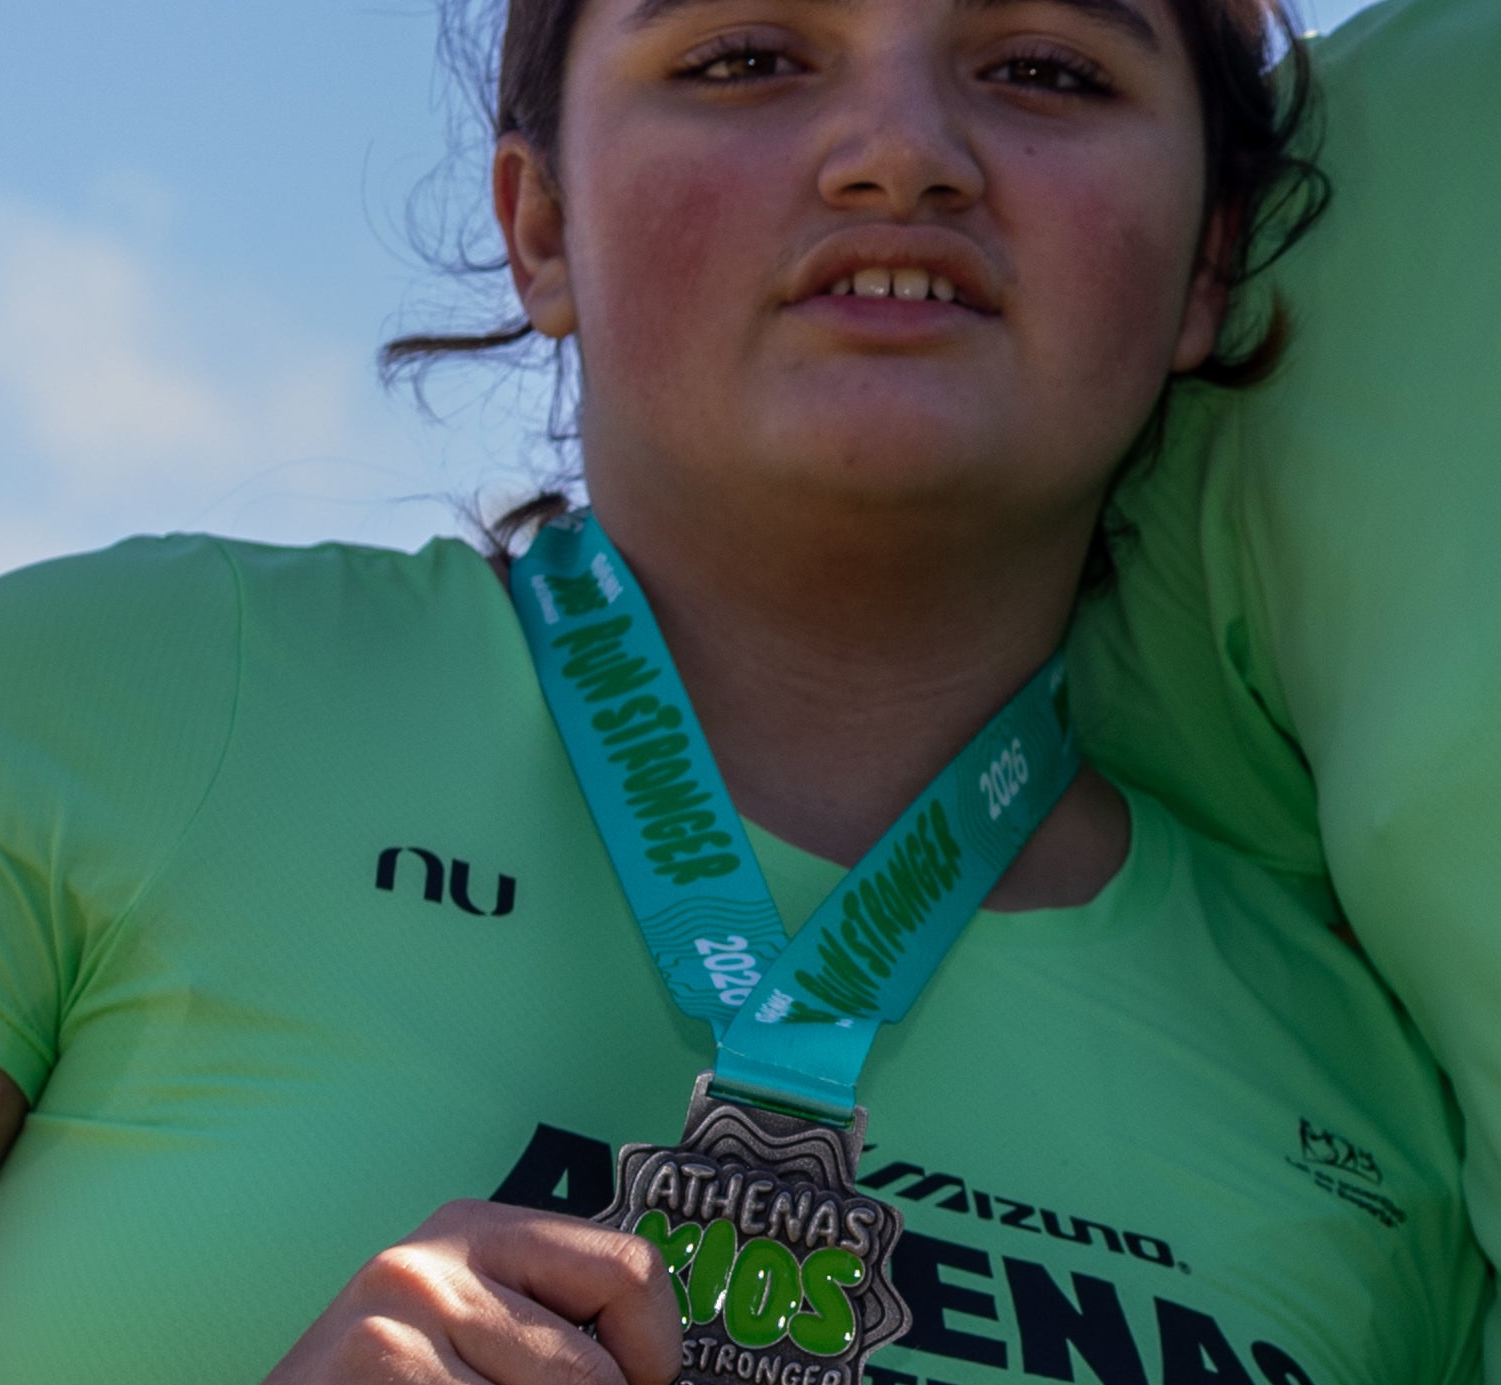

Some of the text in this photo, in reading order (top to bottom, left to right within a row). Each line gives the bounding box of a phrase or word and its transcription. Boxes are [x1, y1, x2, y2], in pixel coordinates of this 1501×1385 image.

[551, 614, 661, 702] RUN
[592, 694, 740, 886] STRONGER
[646, 1160, 875, 1256] ATHENAS
